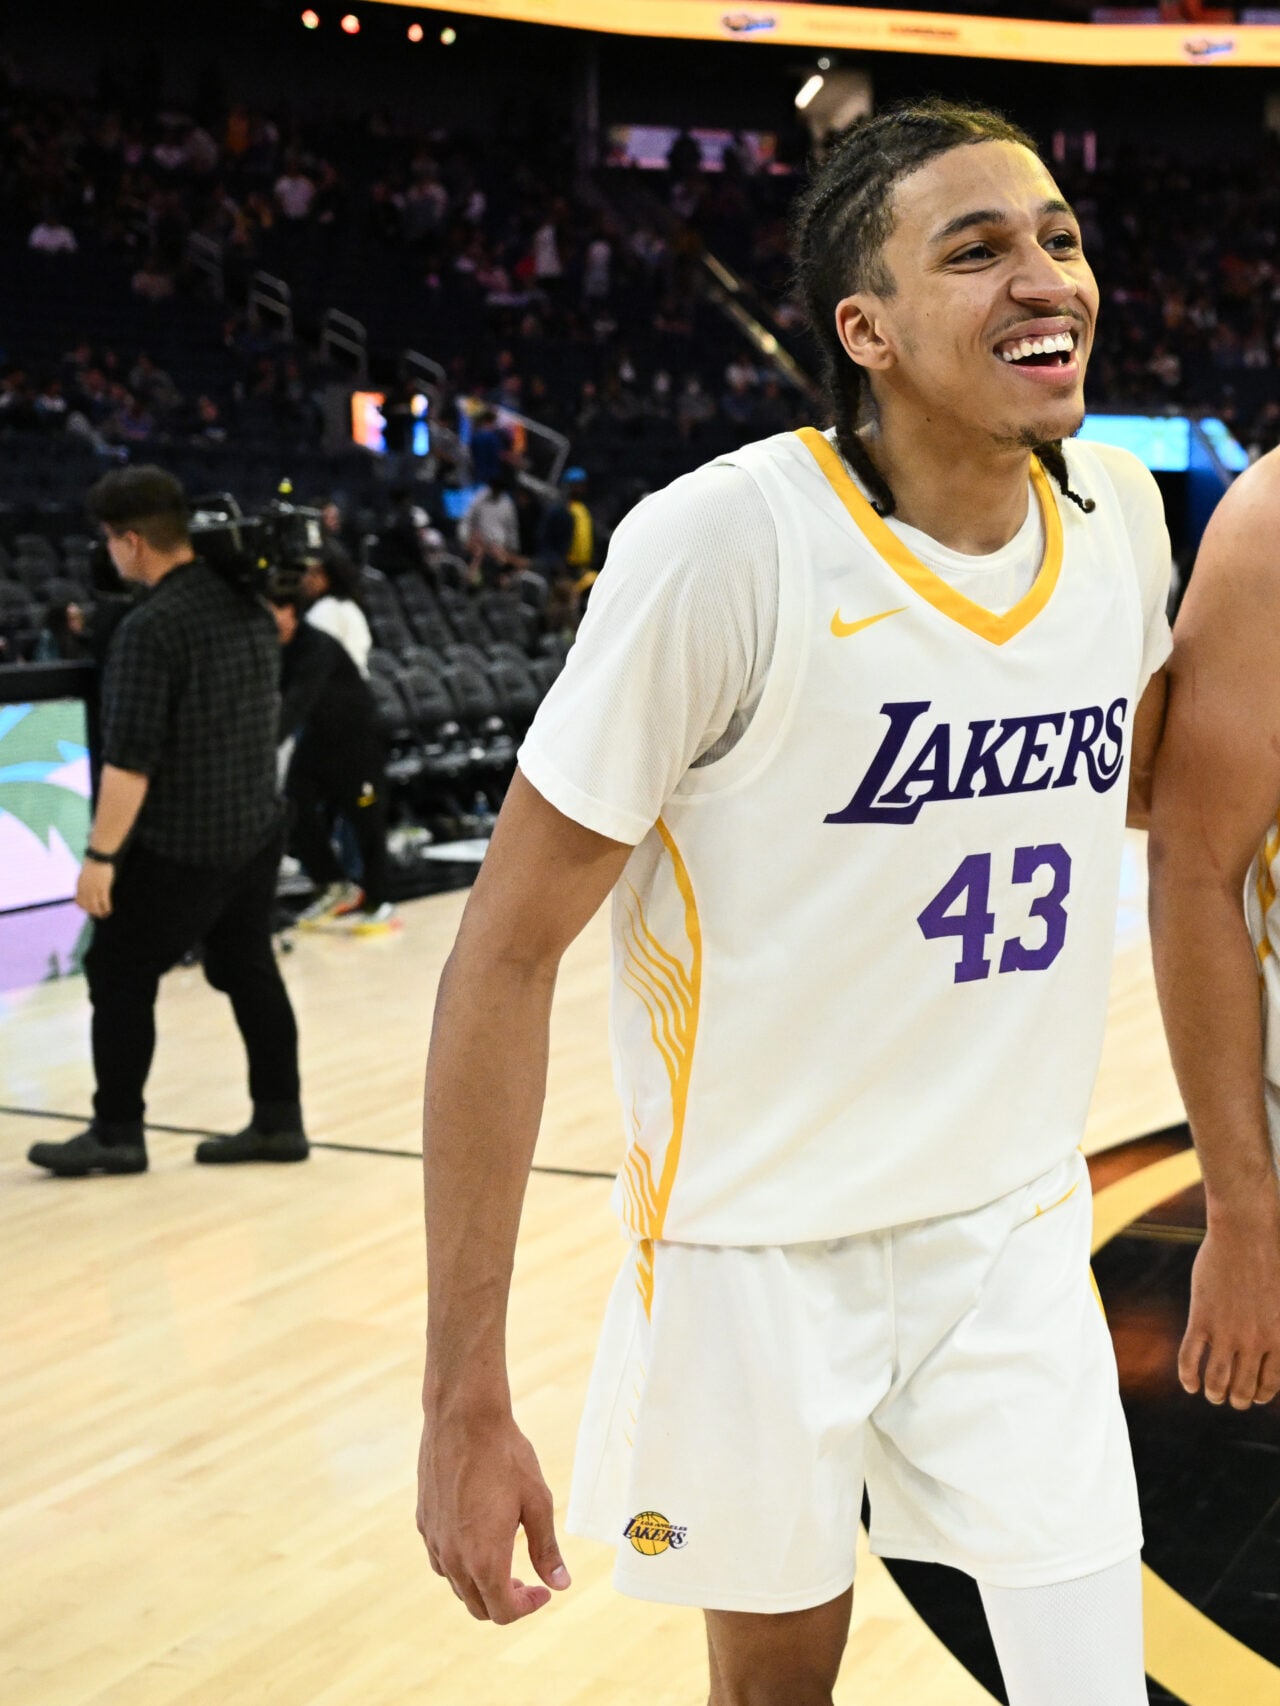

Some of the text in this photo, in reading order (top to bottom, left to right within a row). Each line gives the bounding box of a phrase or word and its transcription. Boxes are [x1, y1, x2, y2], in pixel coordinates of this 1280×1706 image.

[822, 698, 1128, 824] LAKERS
[917, 843, 1072, 983] 43
[623, 1518, 688, 1549] LAKERS
